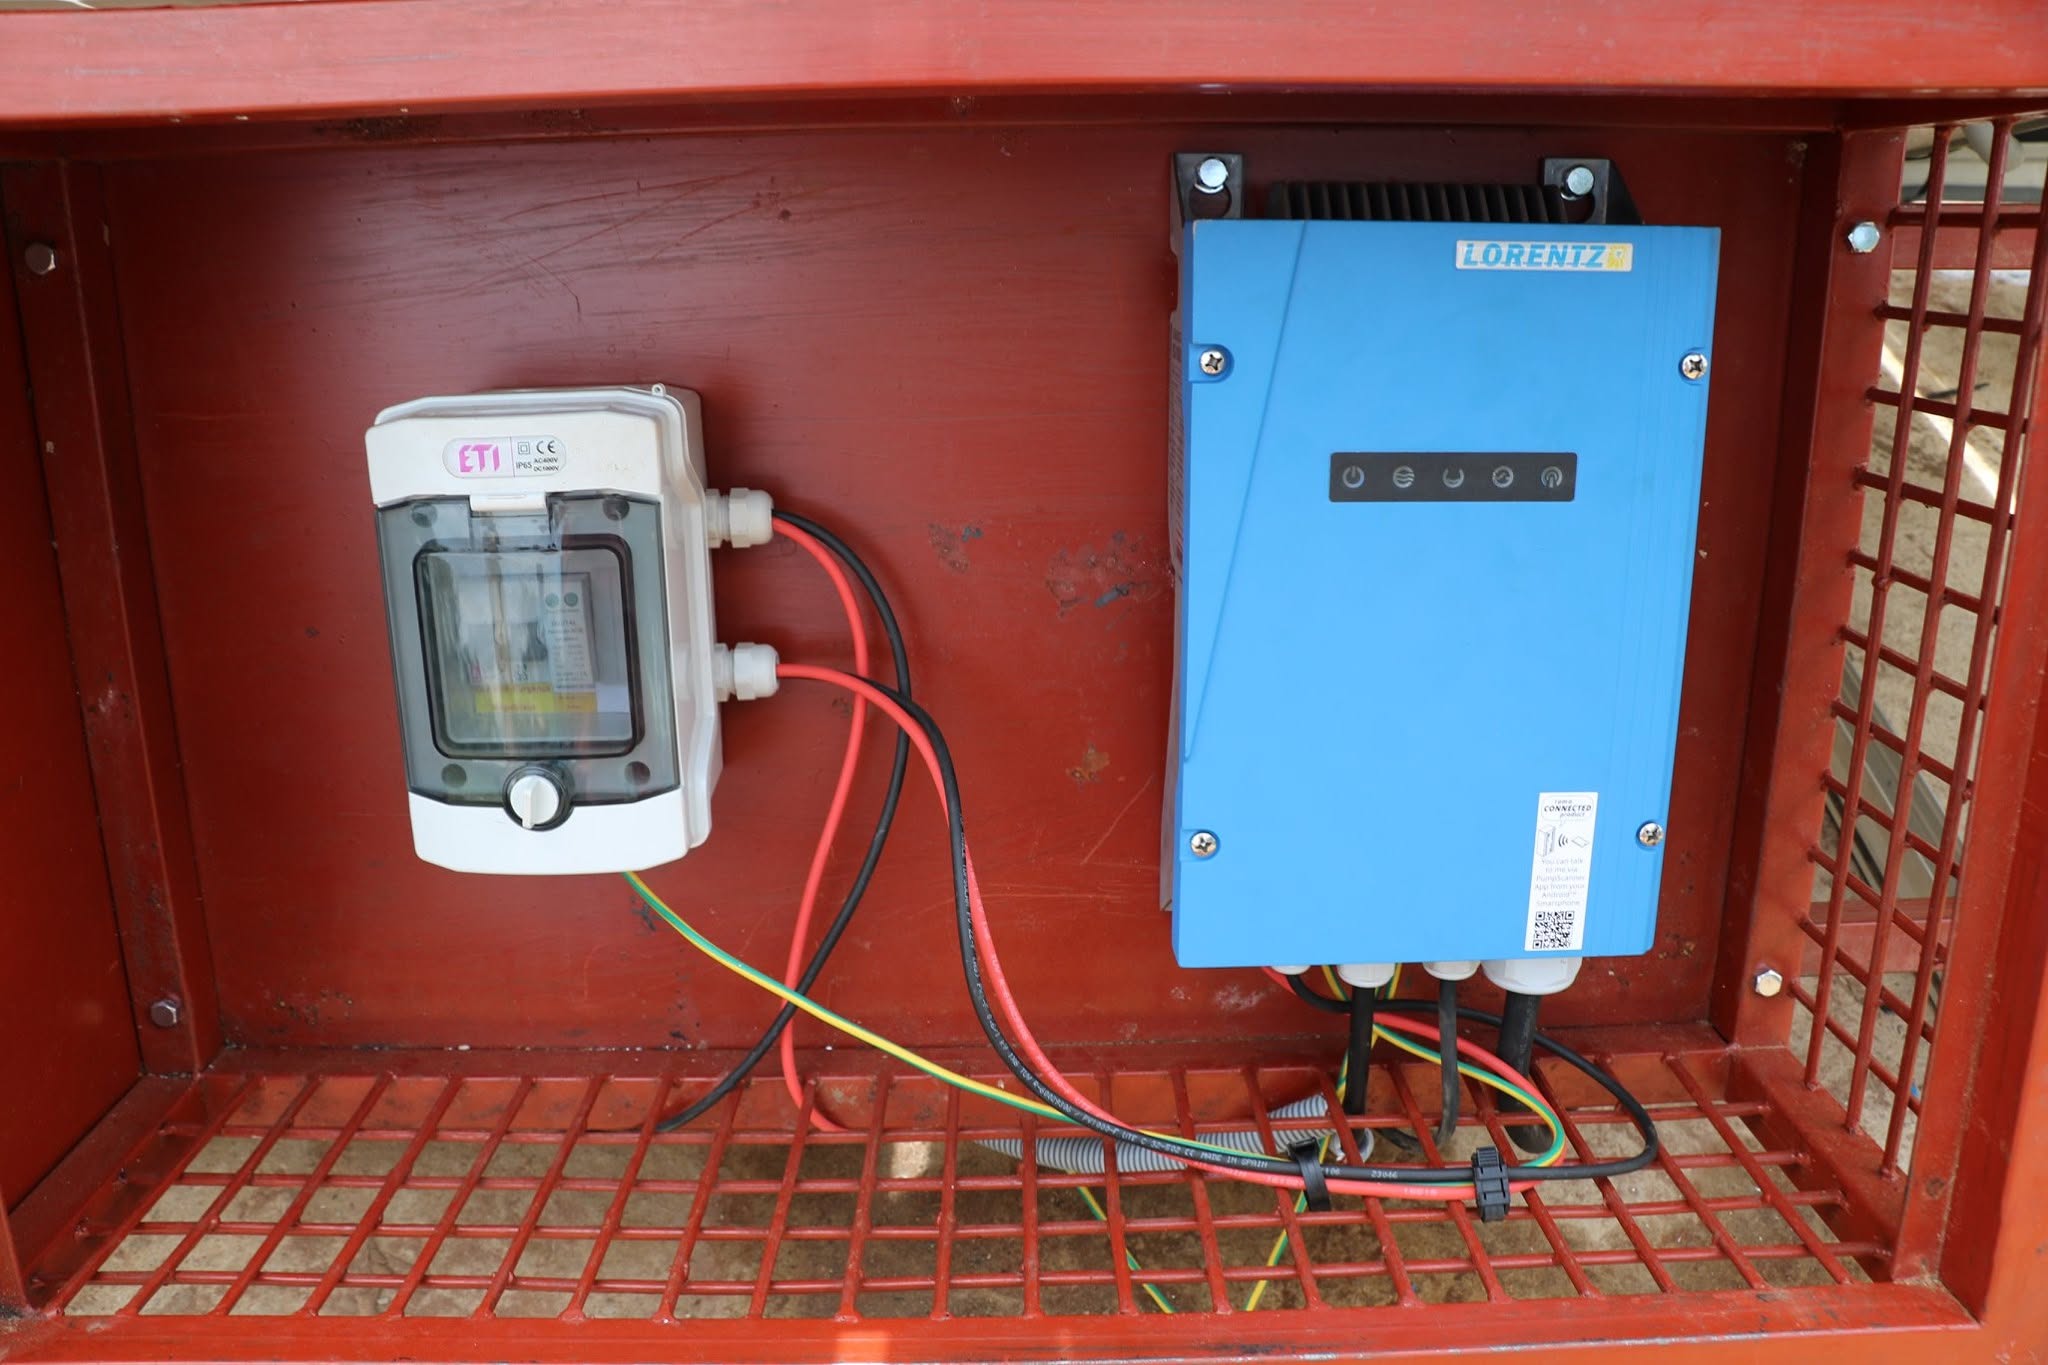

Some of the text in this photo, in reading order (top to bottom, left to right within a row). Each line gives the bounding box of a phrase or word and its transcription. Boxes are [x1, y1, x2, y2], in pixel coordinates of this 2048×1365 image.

[1462, 242, 1606, 268] LORENTZ
[458, 443, 501, 473] ETI
[516, 461, 532, 470] IP65
[1543, 804, 1592, 813] CONNECTED
[1570, 857, 1584, 865] talk
[1200, 1151, 1222, 1163] MADE
[1227, 1155, 1238, 1165] IN
[1241, 1157, 1269, 1169] SPAIN
